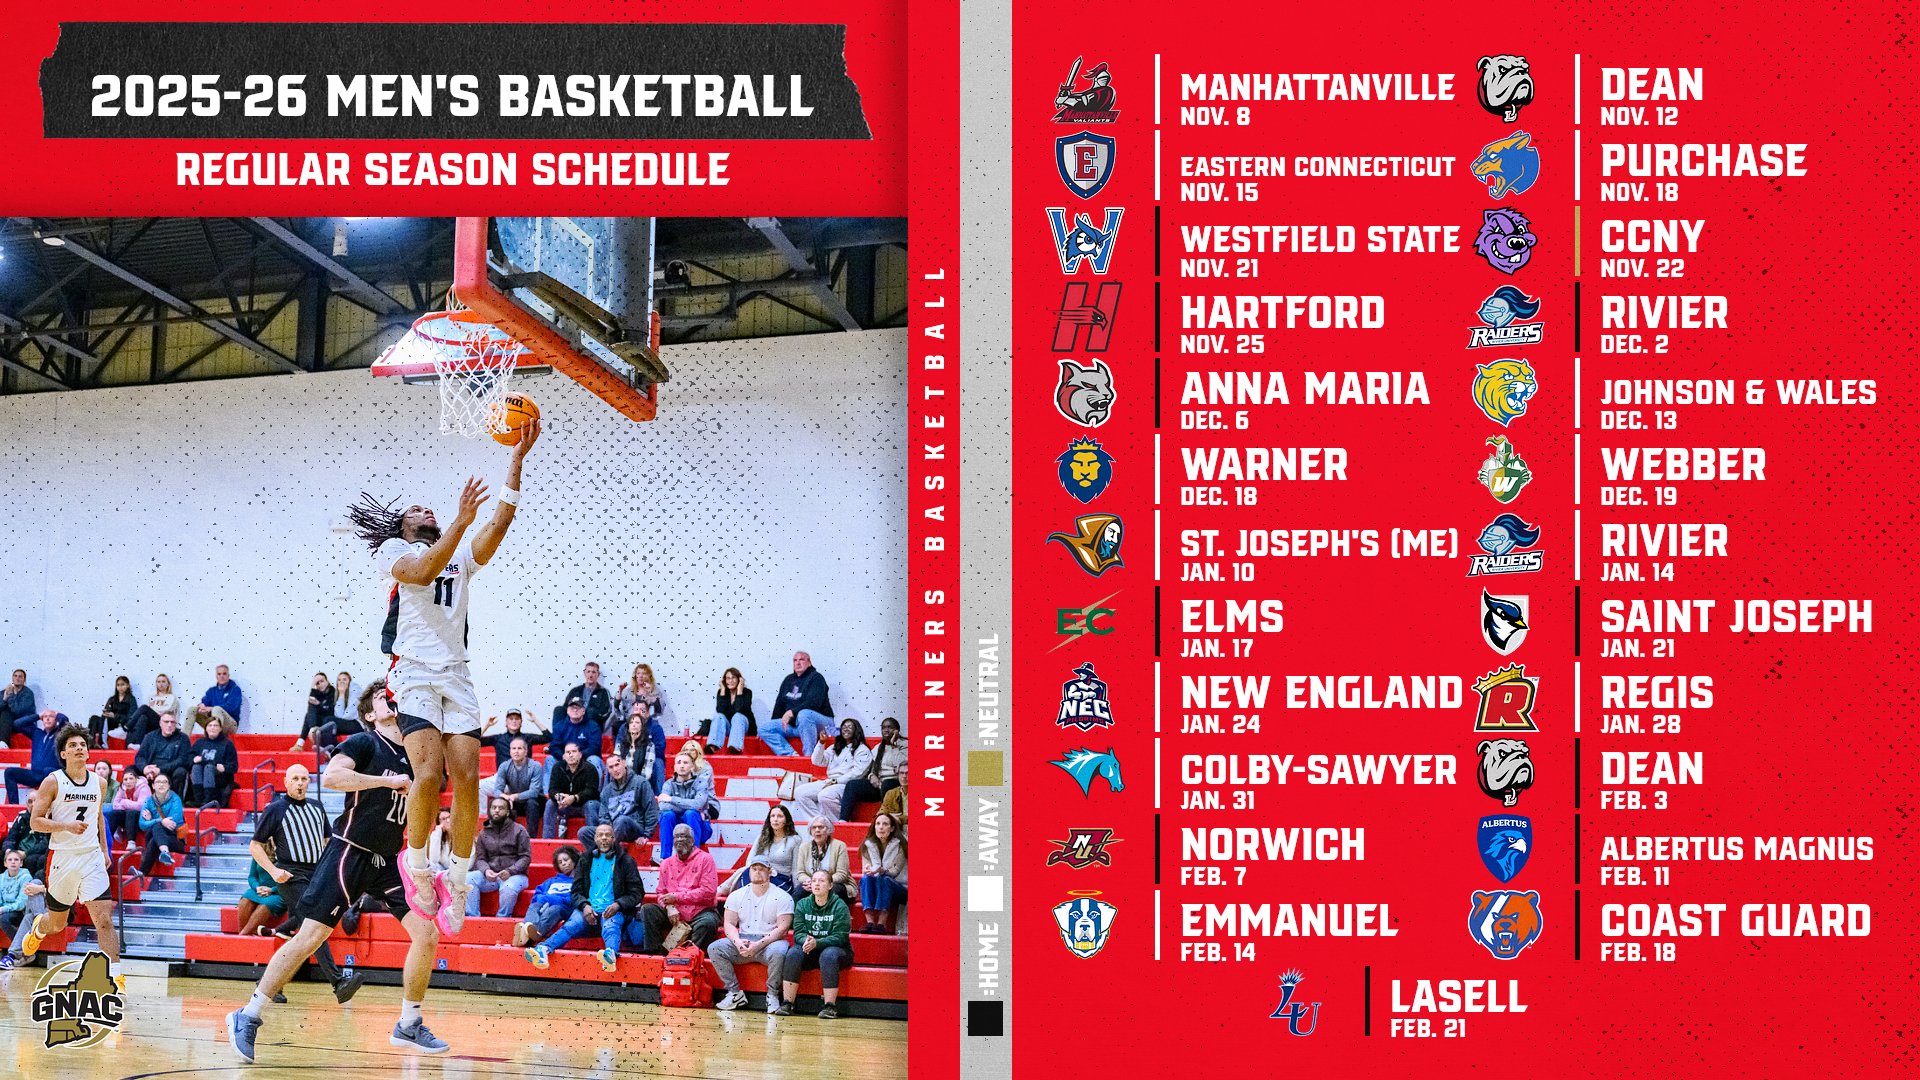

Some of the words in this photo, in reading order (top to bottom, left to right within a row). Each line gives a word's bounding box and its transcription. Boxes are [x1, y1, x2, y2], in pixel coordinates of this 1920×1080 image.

[434, 576, 455, 607] 11
[64, 793, 97, 801] MARINERS
[386, 790, 408, 825] 20
